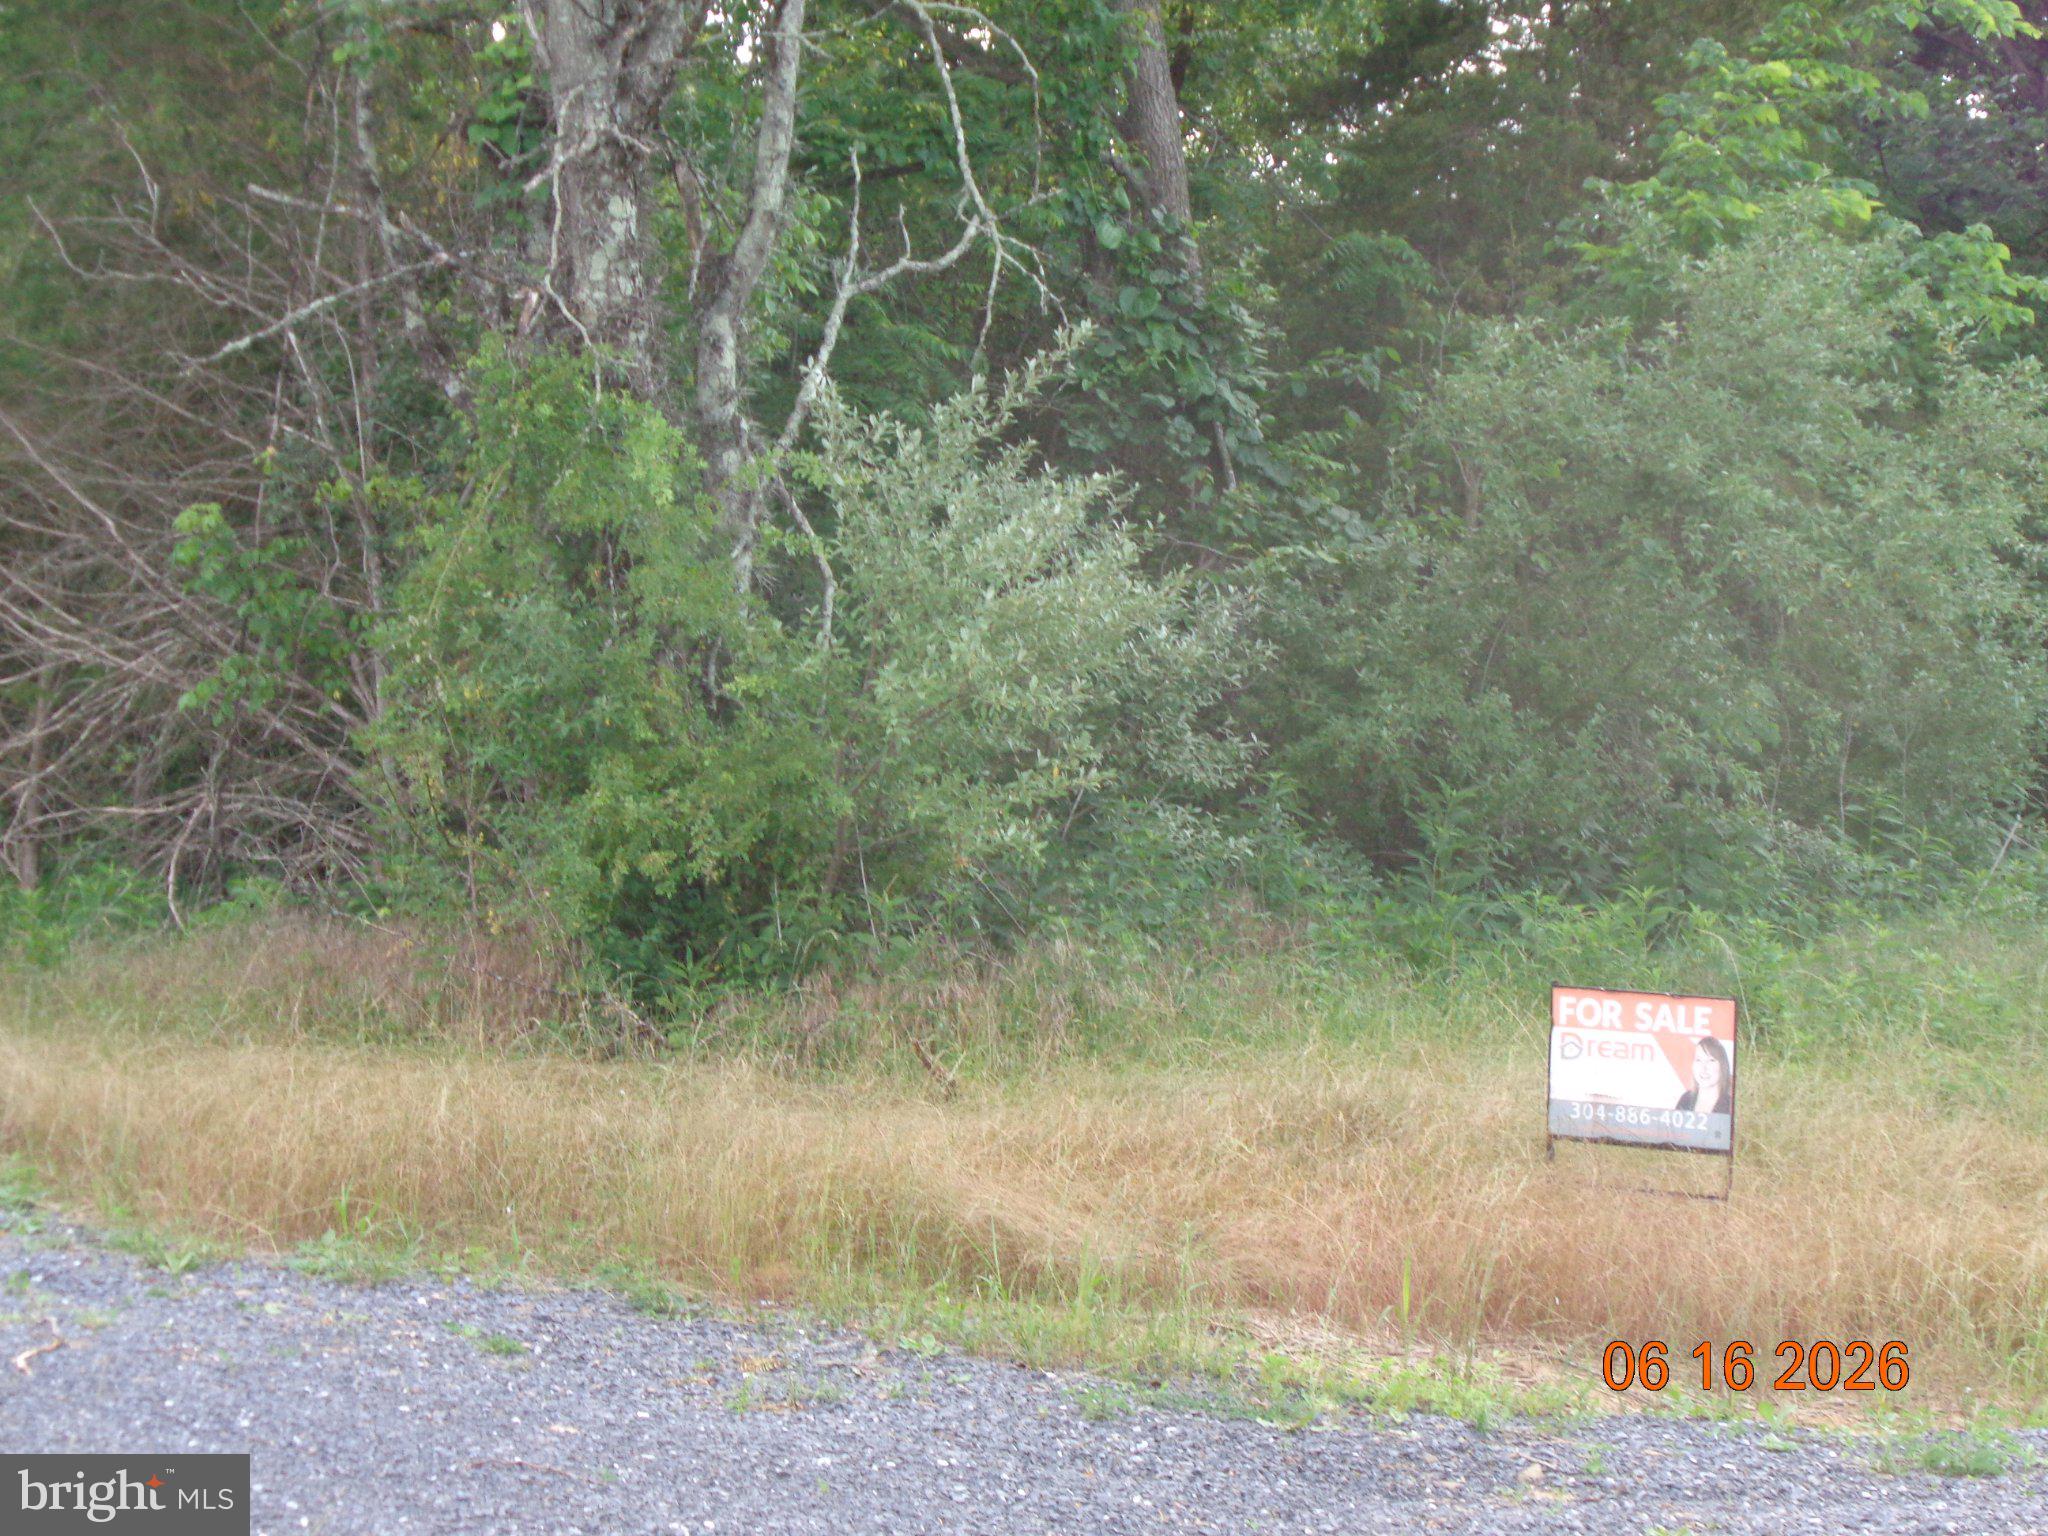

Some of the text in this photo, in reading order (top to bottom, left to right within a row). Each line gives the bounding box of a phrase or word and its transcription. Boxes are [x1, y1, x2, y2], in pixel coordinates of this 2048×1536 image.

[1559, 997, 1712, 1034] FOR SALE
[1561, 1033, 1654, 1061] Dream
[1570, 1102, 1708, 1130] 304-886-4022
